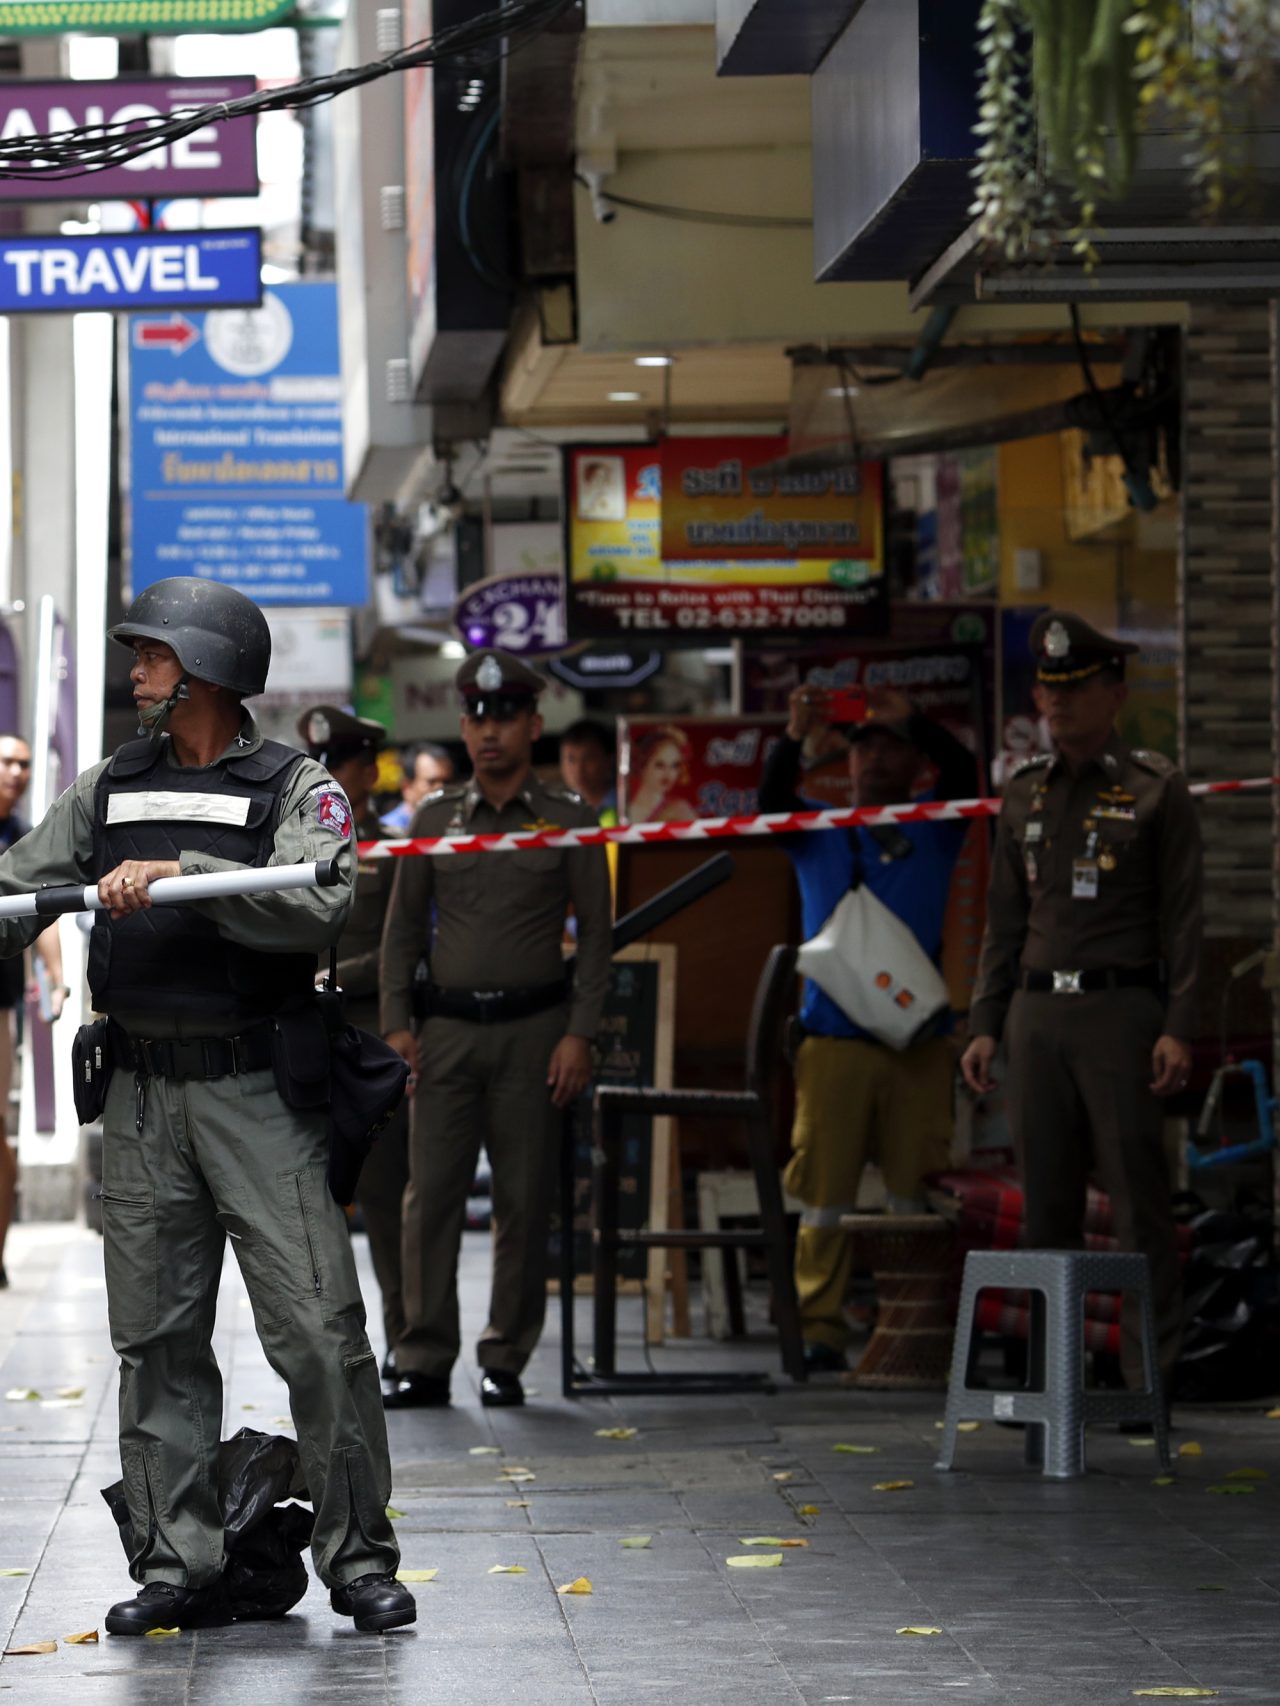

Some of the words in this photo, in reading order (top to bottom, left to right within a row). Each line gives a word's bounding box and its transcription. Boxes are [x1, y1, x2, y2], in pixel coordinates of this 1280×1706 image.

[4, 244, 220, 295] TRAVEL
[493, 600, 564, 650] 24
[615, 608, 669, 629] TEL
